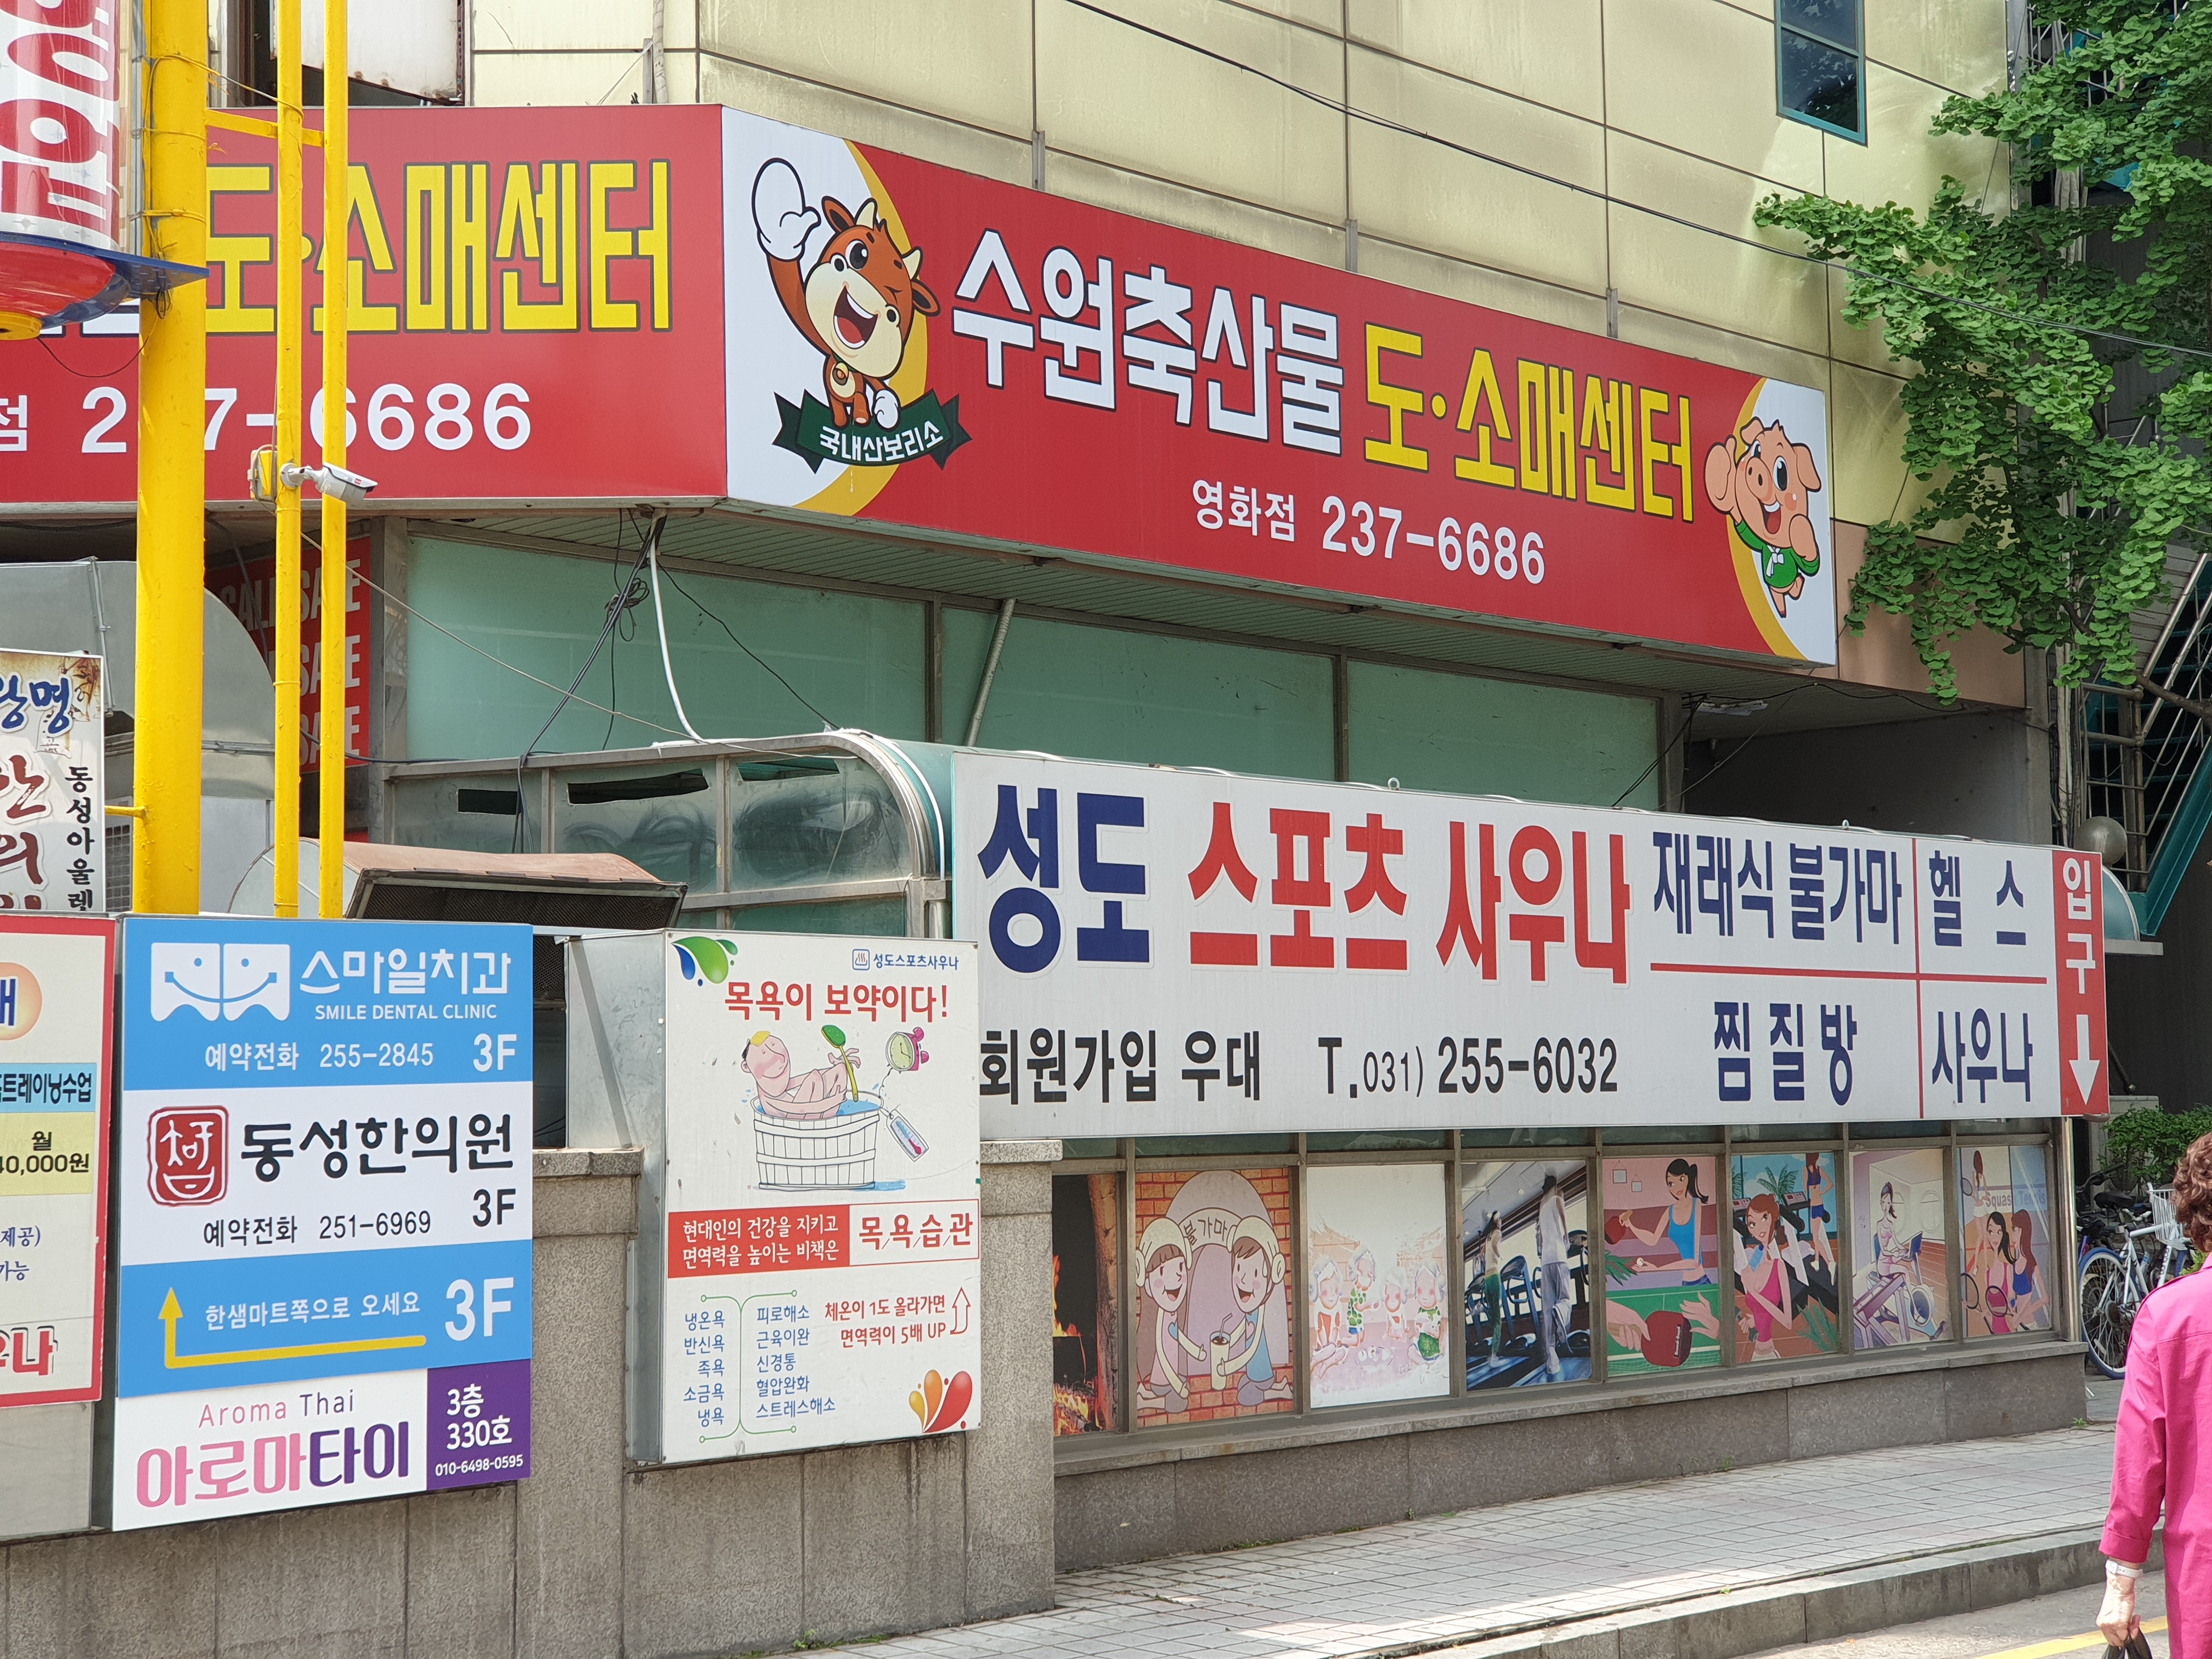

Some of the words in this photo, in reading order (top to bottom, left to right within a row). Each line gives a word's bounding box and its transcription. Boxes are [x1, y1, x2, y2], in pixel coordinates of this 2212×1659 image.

[951, 227, 1344, 456] 수원축산물
[1364, 321, 1694, 523] 도·소매센터
[81, 382, 532, 453] 27-6686
[820, 420, 944, 462] 국내산보리소
[1192, 479, 1295, 542] 영화점
[1322, 495, 1545, 584] 237-6686
[65, 766, 95, 911] 동성아울렛
[977, 784, 1150, 973] 성도
[1187, 802, 1408, 970] 스포츠
[1436, 820, 1630, 985] 사우나
[1652, 831, 1775, 939] 재래식
[1789, 843, 1902, 945] 불가마
[2063, 857, 2096, 995] 입구
[300, 949, 511, 995] 스마일치과
[873, 953, 960, 971] 성도스포츠사우나
[315, 1005, 366, 1020] SMILE
[373, 1005, 438, 1020] DENTAL
[443, 1004, 497, 1020] CLINIC
[725, 981, 812, 1021] 목욕이
[824, 985, 947, 1023] 보약이다!
[205, 1042, 299, 1071] 예약전화
[320, 1043, 434, 1069] 255-2845
[472, 1034, 517, 1071] 3F
[980, 1028, 1156, 1105] 회원가입
[1182, 1030, 1260, 1102] 우대
[1438, 1036, 1618, 1094] 255-6032
[1932, 1008, 2033, 1104] 사우나
[0, 1072, 92, 1105] 트레이닝수업
[32, 1131, 53, 1152] 월
[241, 1113, 514, 1182] 동성한의원
[472, 1188, 516, 1227] 3F
[204, 1215, 298, 1248] 예약전화
[319, 1210, 431, 1240] 251-6969
[683, 1218, 742, 1243] 현대인의
[747, 1216, 792, 1239] 건강을
[797, 1214, 839, 1235] 지키고
[683, 1245, 742, 1269] 면역력을
[747, 1242, 792, 1266] 높이는
[797, 1240, 839, 1262] 비책은
[205, 1296, 351, 1331] 한샘마트쪽으로
[360, 1291, 421, 1317] 오세요
[445, 1277, 515, 1341] 3F
[685, 1310, 726, 1331] 냉온욕
[757, 1305, 810, 1324] 피로해소
[825, 1301, 865, 1322] 체온이
[869, 1298, 891, 1317] 1도
[894, 1294, 946, 1317] 올라가면
[684, 1335, 726, 1355] 반신욕
[756, 1328, 810, 1350] 근육이완
[840, 1325, 896, 1348] 면역력이
[901, 1324, 923, 1344] 5배
[928, 1323, 946, 1339] UP
[697, 1358, 726, 1377] 족욕
[757, 1353, 797, 1373] 신경통
[447, 1384, 484, 1418] 3층
[684, 1383, 725, 1404] 소금욕
[756, 1375, 810, 1397] 혈압완화
[199, 1403, 287, 1428] Aroma
[300, 1389, 354, 1417] Thai
[697, 1407, 725, 1427] 냉욕
[755, 1397, 836, 1419] 스트레스해소
[447, 1415, 512, 1450] 330호
[137, 1421, 409, 1508] 아로마타이
[435, 1454, 524, 1477] 010-6498-0595
